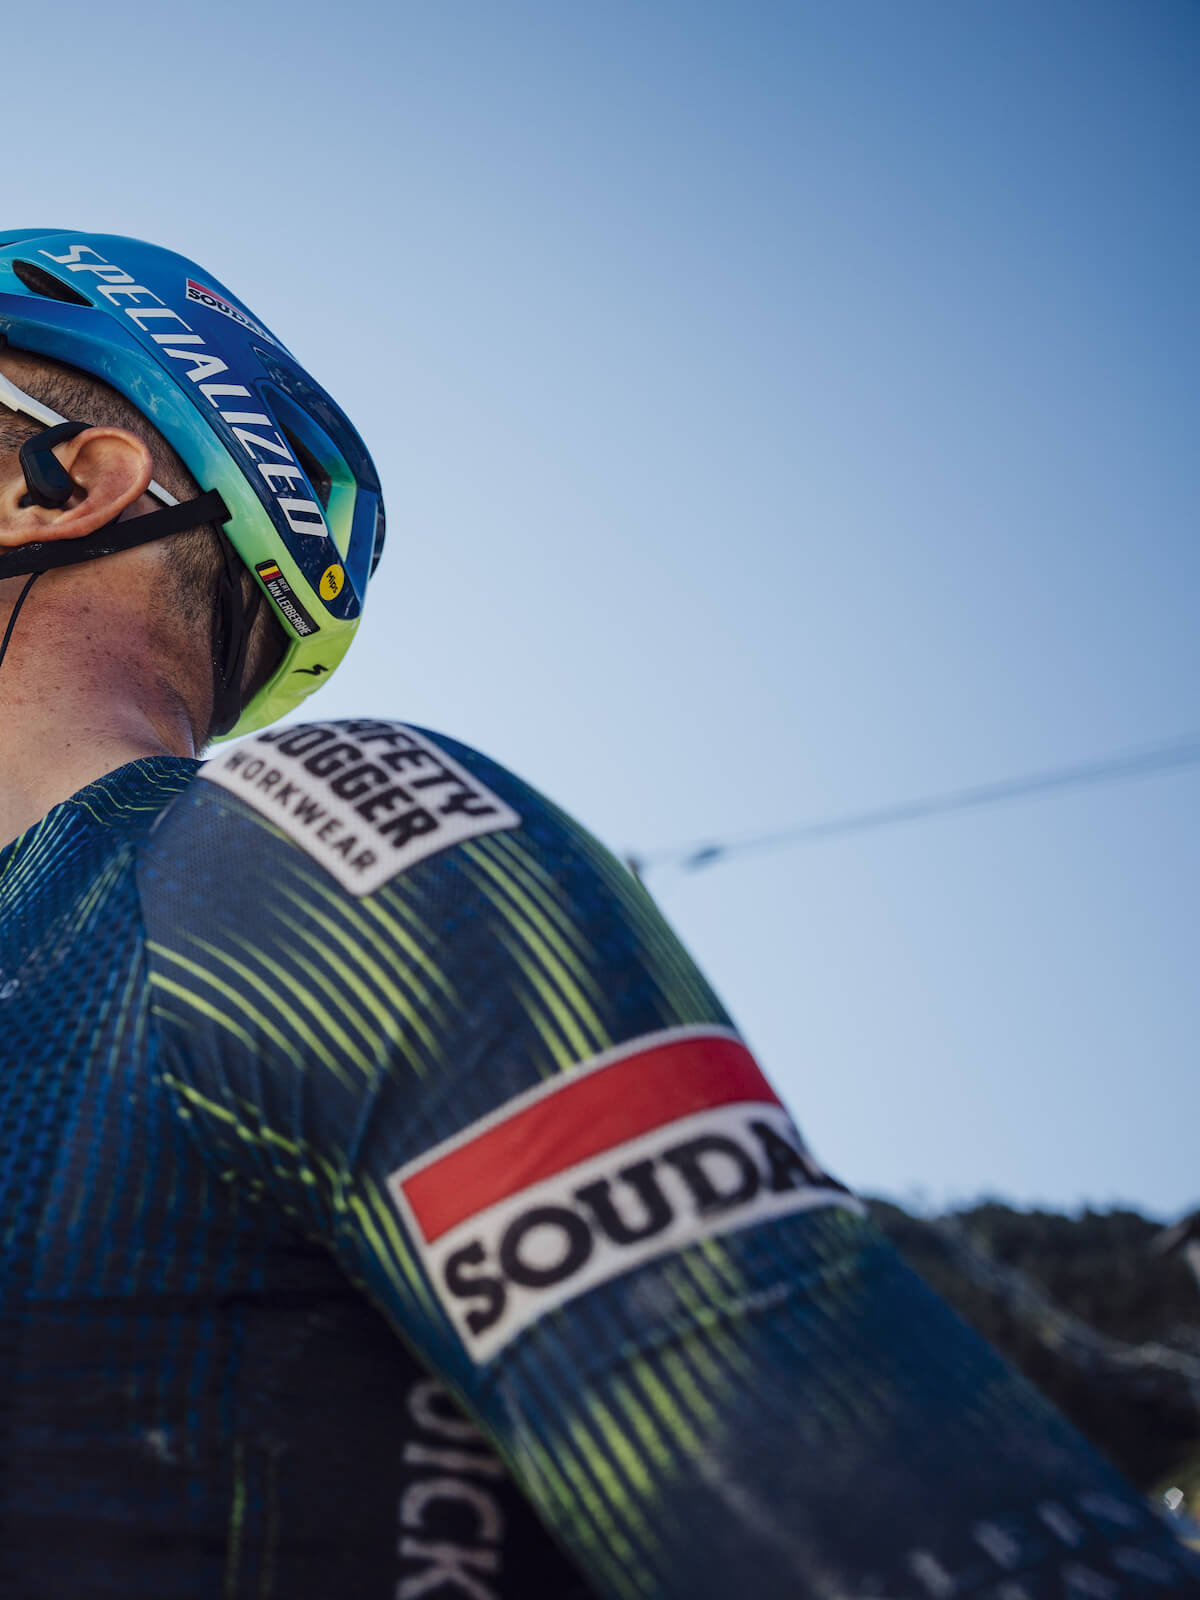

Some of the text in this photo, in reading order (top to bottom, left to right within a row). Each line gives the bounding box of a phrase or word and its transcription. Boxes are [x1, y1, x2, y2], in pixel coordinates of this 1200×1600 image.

[188, 288, 273, 342] SOUD
[38, 245, 328, 537] SPECIALIZED
[267, 581, 311, 636] VAN LERBERGHE
[277, 578, 290, 592] BERT
[326, 571, 338, 594] Mips
[225, 752, 377, 873] WORKWEAR
[257, 724, 439, 848] JOGGER
[445, 1120, 854, 1337] SOUDA
[397, 1377, 503, 1600] UICK
